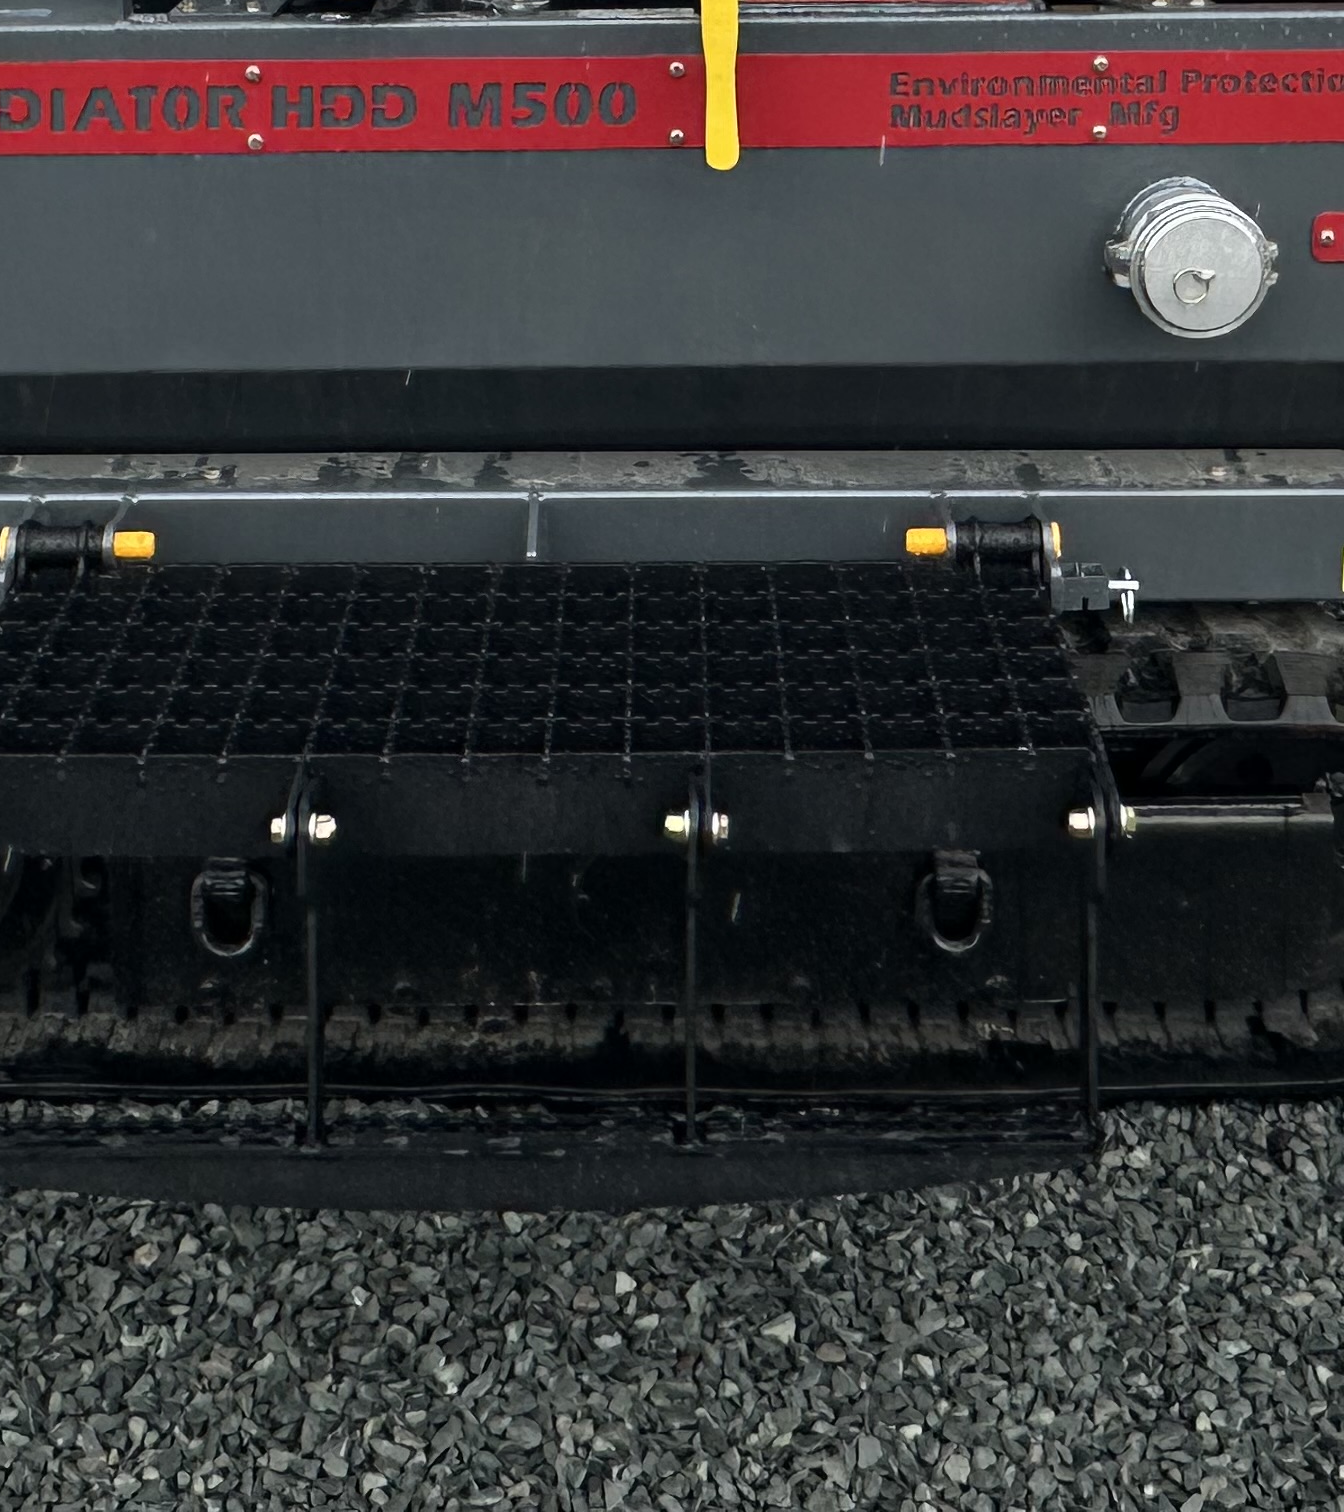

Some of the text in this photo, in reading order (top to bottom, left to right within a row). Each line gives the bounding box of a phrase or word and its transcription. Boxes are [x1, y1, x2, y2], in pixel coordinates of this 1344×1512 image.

[889, 70, 1167, 97] Environmental
[271, 84, 417, 129] HDD
[448, 82, 637, 128] M500
[890, 100, 1179, 135] Mudslayer Mfg
